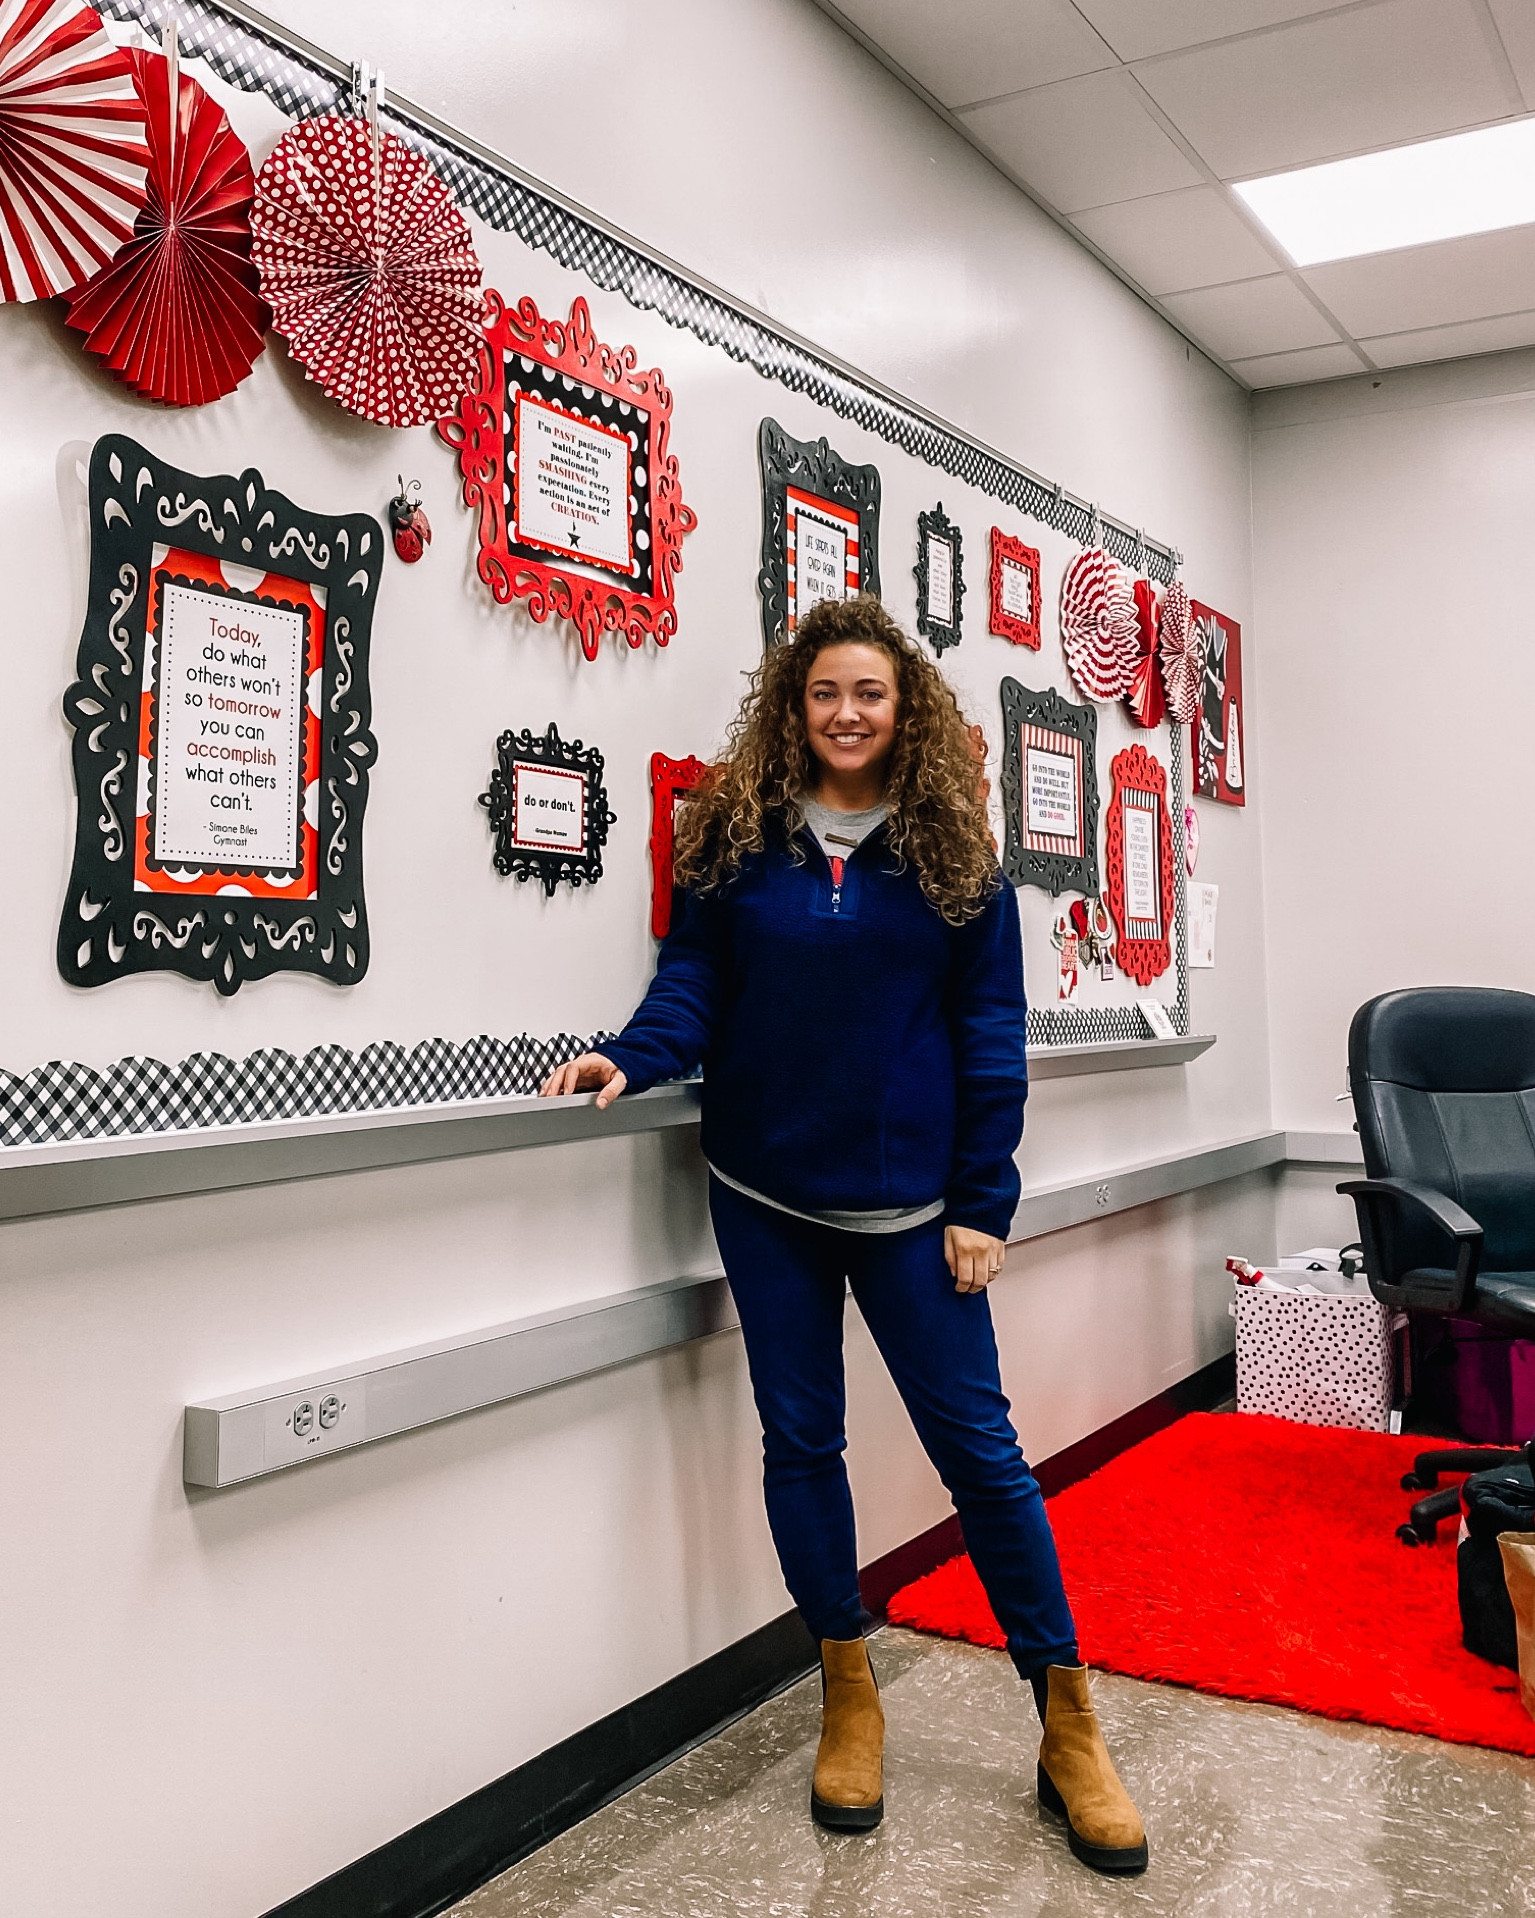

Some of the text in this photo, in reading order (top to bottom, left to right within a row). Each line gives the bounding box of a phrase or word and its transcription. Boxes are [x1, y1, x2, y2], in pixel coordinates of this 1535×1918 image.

[537, 420, 613, 459] I'm PAST patiently
[552, 440, 599, 465] waiting. I'm
[538, 460, 610, 494] SMASHING every
[550, 453, 599, 478] passionately
[537, 473, 610, 506] expectation. Every
[539, 487, 610, 517] action is an act of
[551, 501, 600, 526] CREATION.
[823, 562, 836, 578] AGAIN
[209, 617, 261, 648] Today,
[202, 645, 267, 670] do what
[186, 666, 281, 696] others won't
[184, 692, 282, 719] so tomorrow
[200, 719, 265, 741] you can
[187, 741, 277, 766] accomplish
[185, 762, 277, 789] what others
[210, 792, 253, 811] can't.
[524, 795, 576, 812] do or don't.
[209, 822, 238, 835] Simone
[239, 824, 258, 836] Biles
[213, 834, 248, 848] Gymnast
